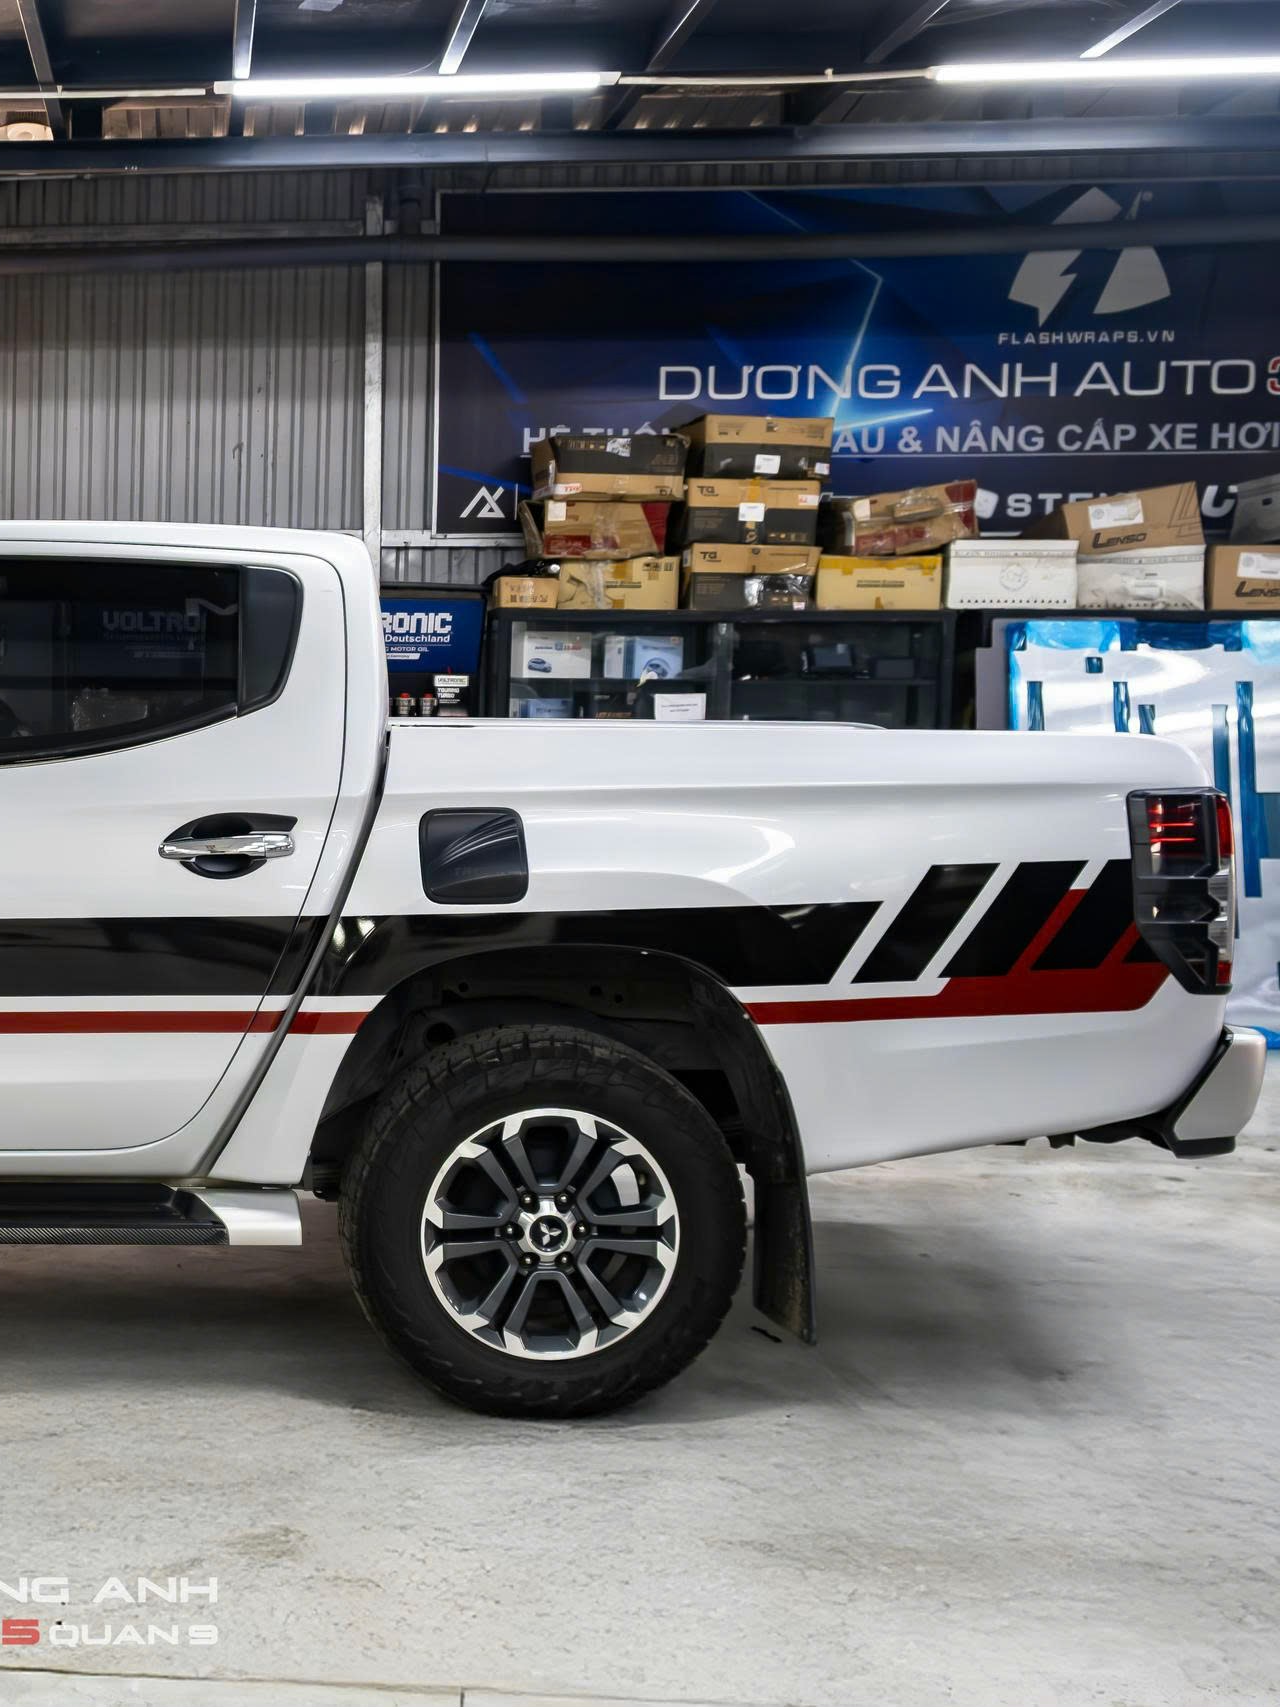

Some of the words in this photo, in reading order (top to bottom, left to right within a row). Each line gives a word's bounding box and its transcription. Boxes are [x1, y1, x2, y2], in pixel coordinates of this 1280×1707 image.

[998, 329, 1176, 345] FLASHWRAPS.VN
[658, 364, 901, 400] DƯƠNG
[912, 362, 1058, 399] ANH
[1074, 359, 1256, 397] AUTO
[897, 425, 923, 452] &
[936, 420, 1045, 452] NÂNG
[1057, 418, 1136, 451] CẤP
[1148, 422, 1198, 450] XE
[381, 612, 453, 634] RONIC
[385, 634, 451, 643] Deutschland
